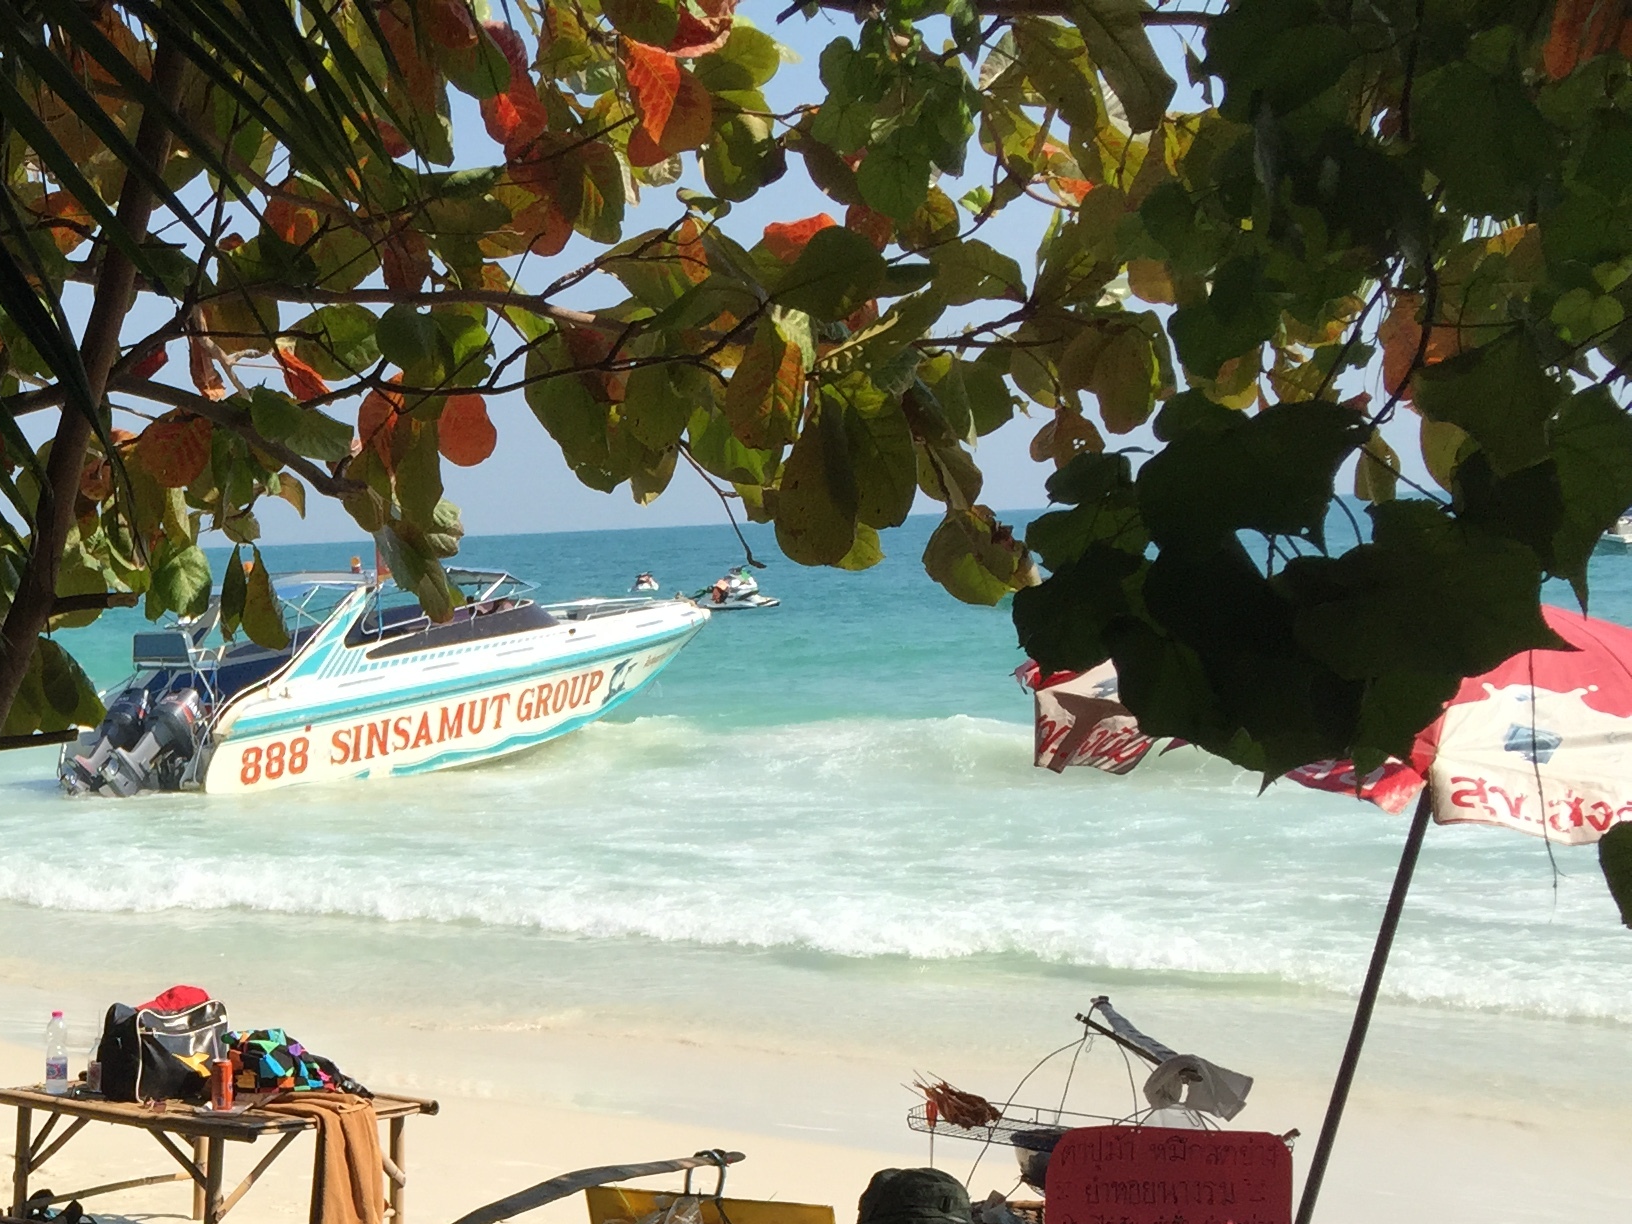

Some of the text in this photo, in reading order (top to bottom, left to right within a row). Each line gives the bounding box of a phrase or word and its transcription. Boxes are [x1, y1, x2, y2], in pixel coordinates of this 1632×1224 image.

[240, 668, 604, 787] 888 SINSAMUT GROUP
